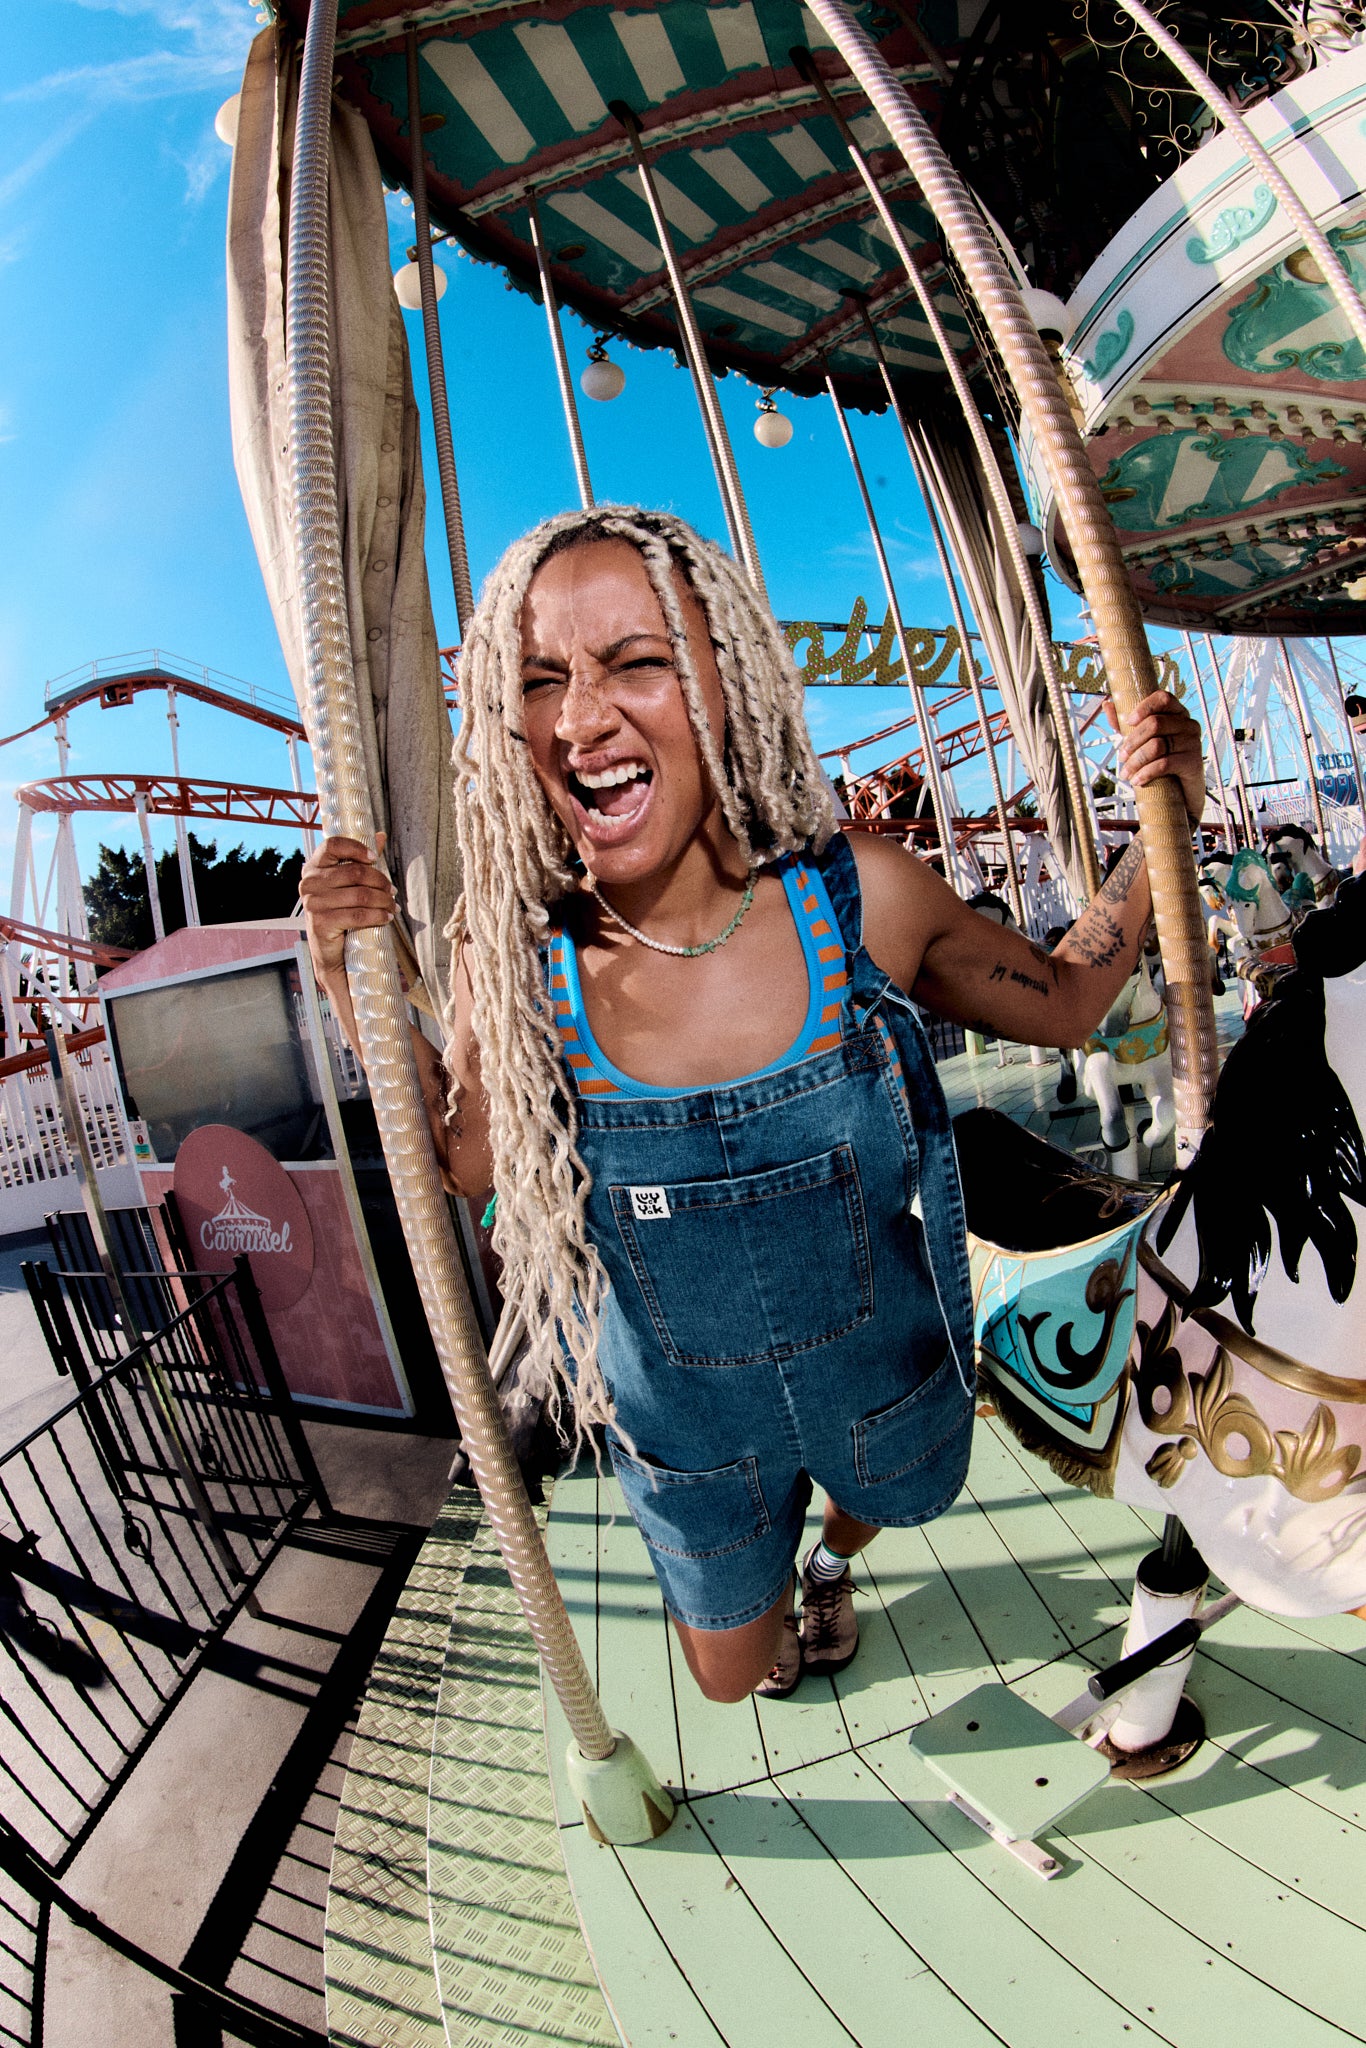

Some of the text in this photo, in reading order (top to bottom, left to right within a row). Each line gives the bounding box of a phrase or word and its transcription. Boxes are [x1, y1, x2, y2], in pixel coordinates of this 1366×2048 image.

[784, 596, 983, 685] oller
[1316, 752, 1353, 770] RUED
[200, 1221, 293, 1252] Carrusel
